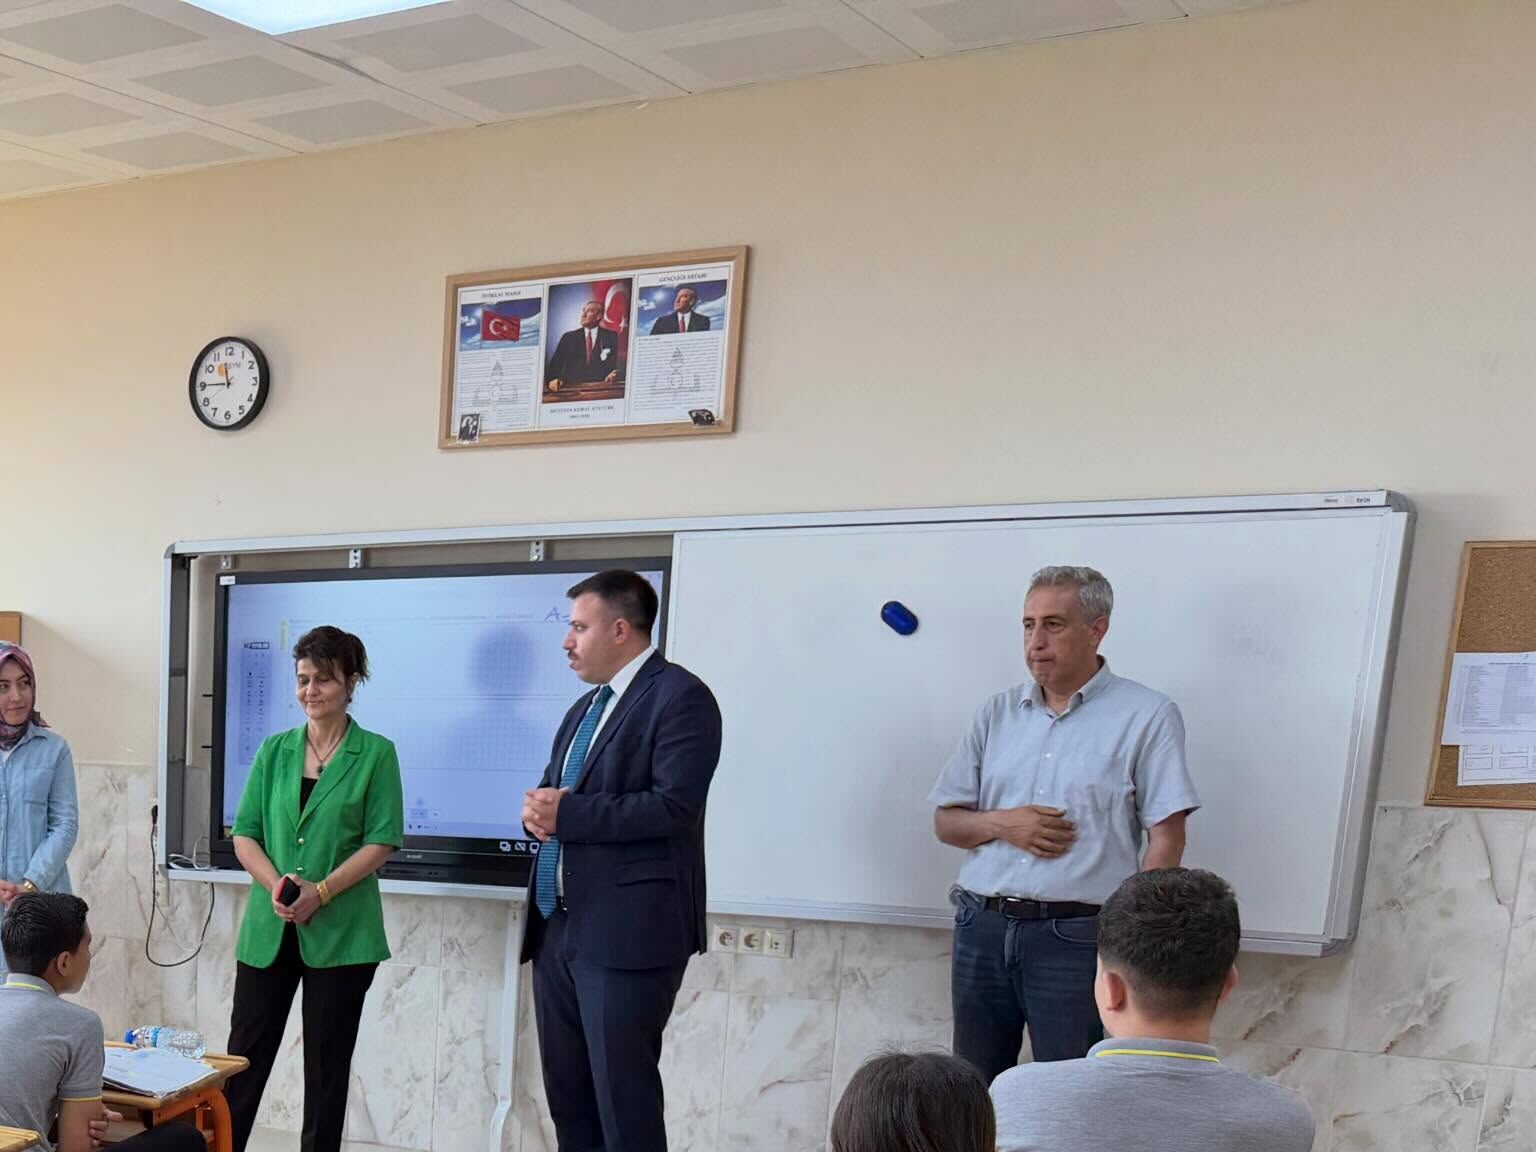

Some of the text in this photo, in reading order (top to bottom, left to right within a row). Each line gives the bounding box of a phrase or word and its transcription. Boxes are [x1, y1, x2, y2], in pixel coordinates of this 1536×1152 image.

[225, 346, 235, 357] 12
[213, 352, 220, 362] 11
[205, 364, 215, 374] 10
[248, 360, 255, 370] 2
[199, 381, 207, 391] 9
[252, 376, 258, 386] 3
[202, 397, 210, 407] 8
[247, 393, 254, 402] 4
[211, 407, 218, 417] 7
[238, 405, 245, 415] 5
[224, 411, 232, 420] 6
